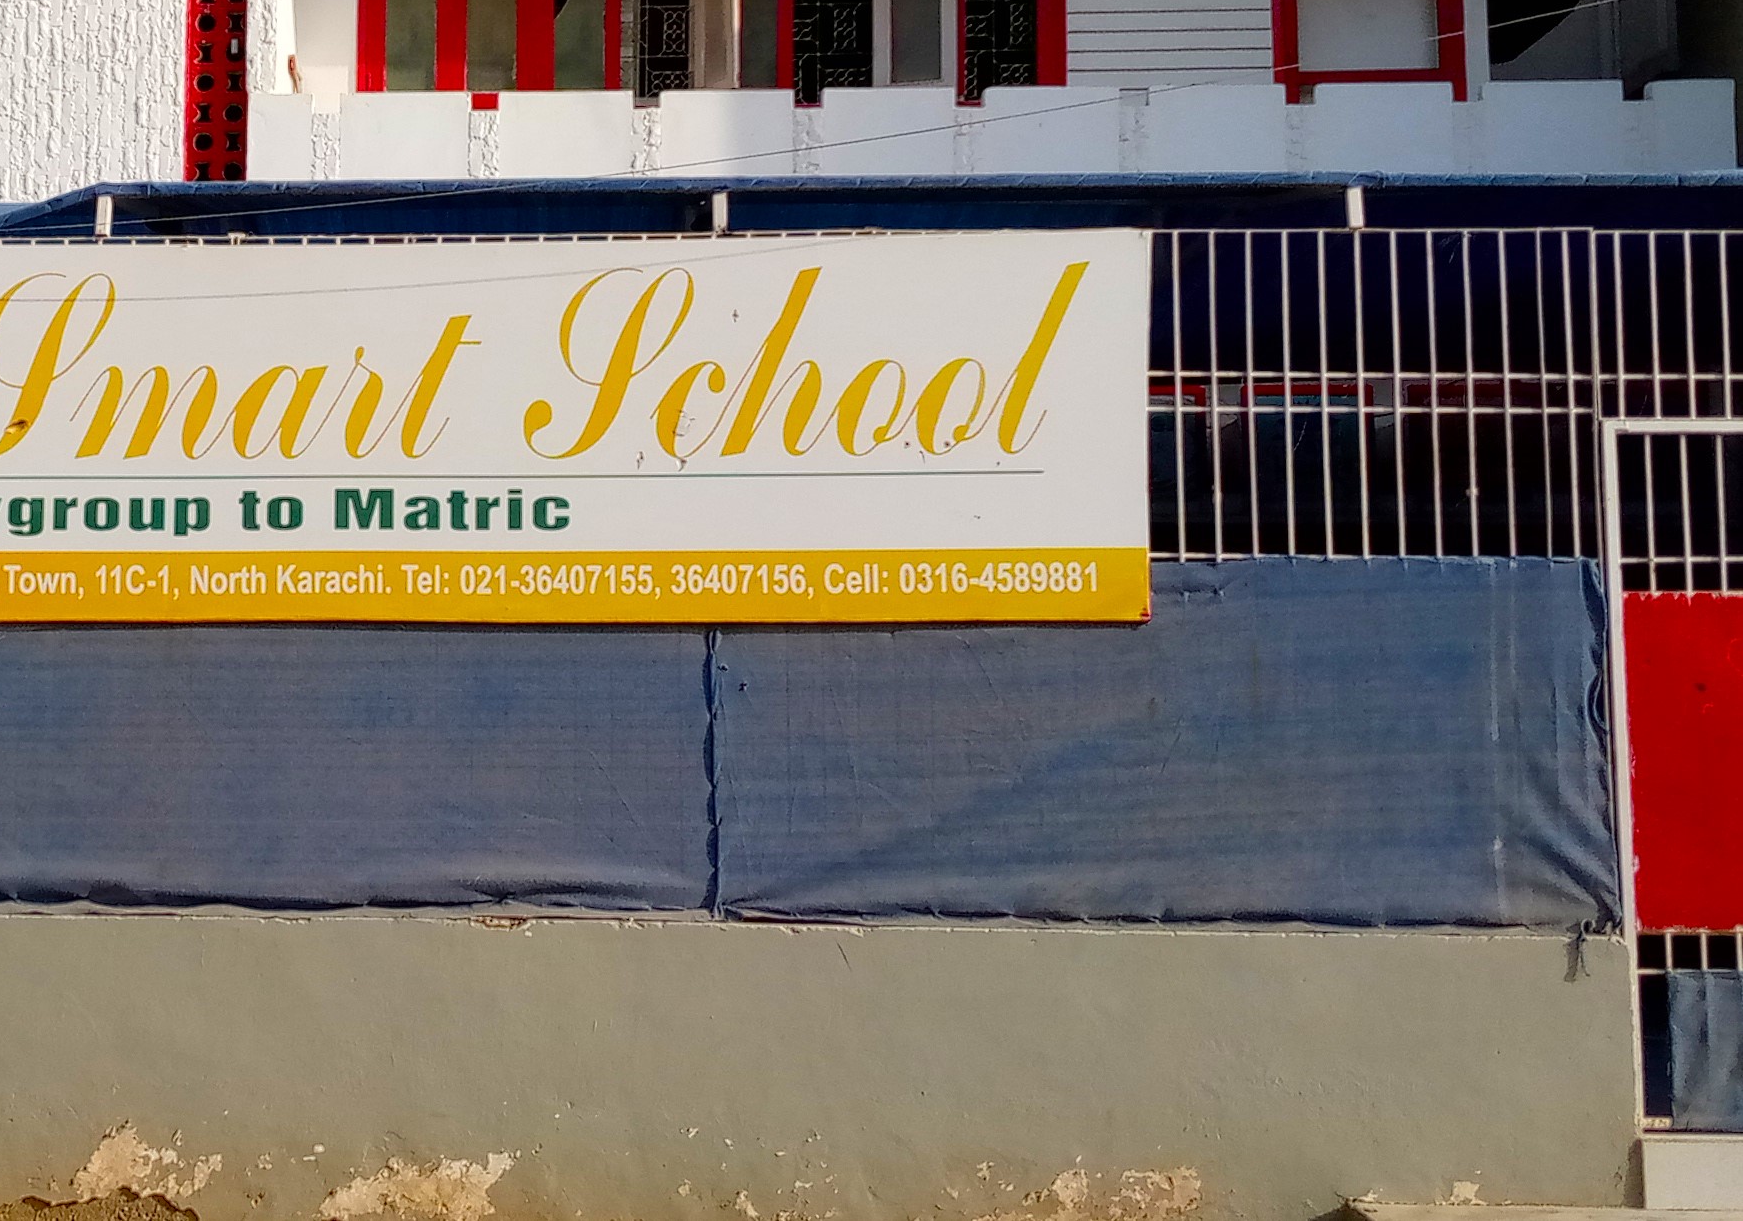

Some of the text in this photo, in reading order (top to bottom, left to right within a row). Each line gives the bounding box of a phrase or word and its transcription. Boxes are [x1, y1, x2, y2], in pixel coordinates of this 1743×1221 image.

[523, 261, 1090, 459] School
[240, 490, 304, 530] to
[335, 488, 571, 531] Matric
[3, 564, 85, 599] Town,
[95, 564, 179, 599] 11C-1,
[190, 565, 267, 594] North
[277, 564, 392, 594] Karachi.
[401, 564, 450, 594] Tel:
[460, 564, 662, 598] 021-36407155,
[671, 564, 815, 598] 36407156,
[824, 563, 890, 594] Cell:
[899, 561, 1098, 594] 0316-4589881
